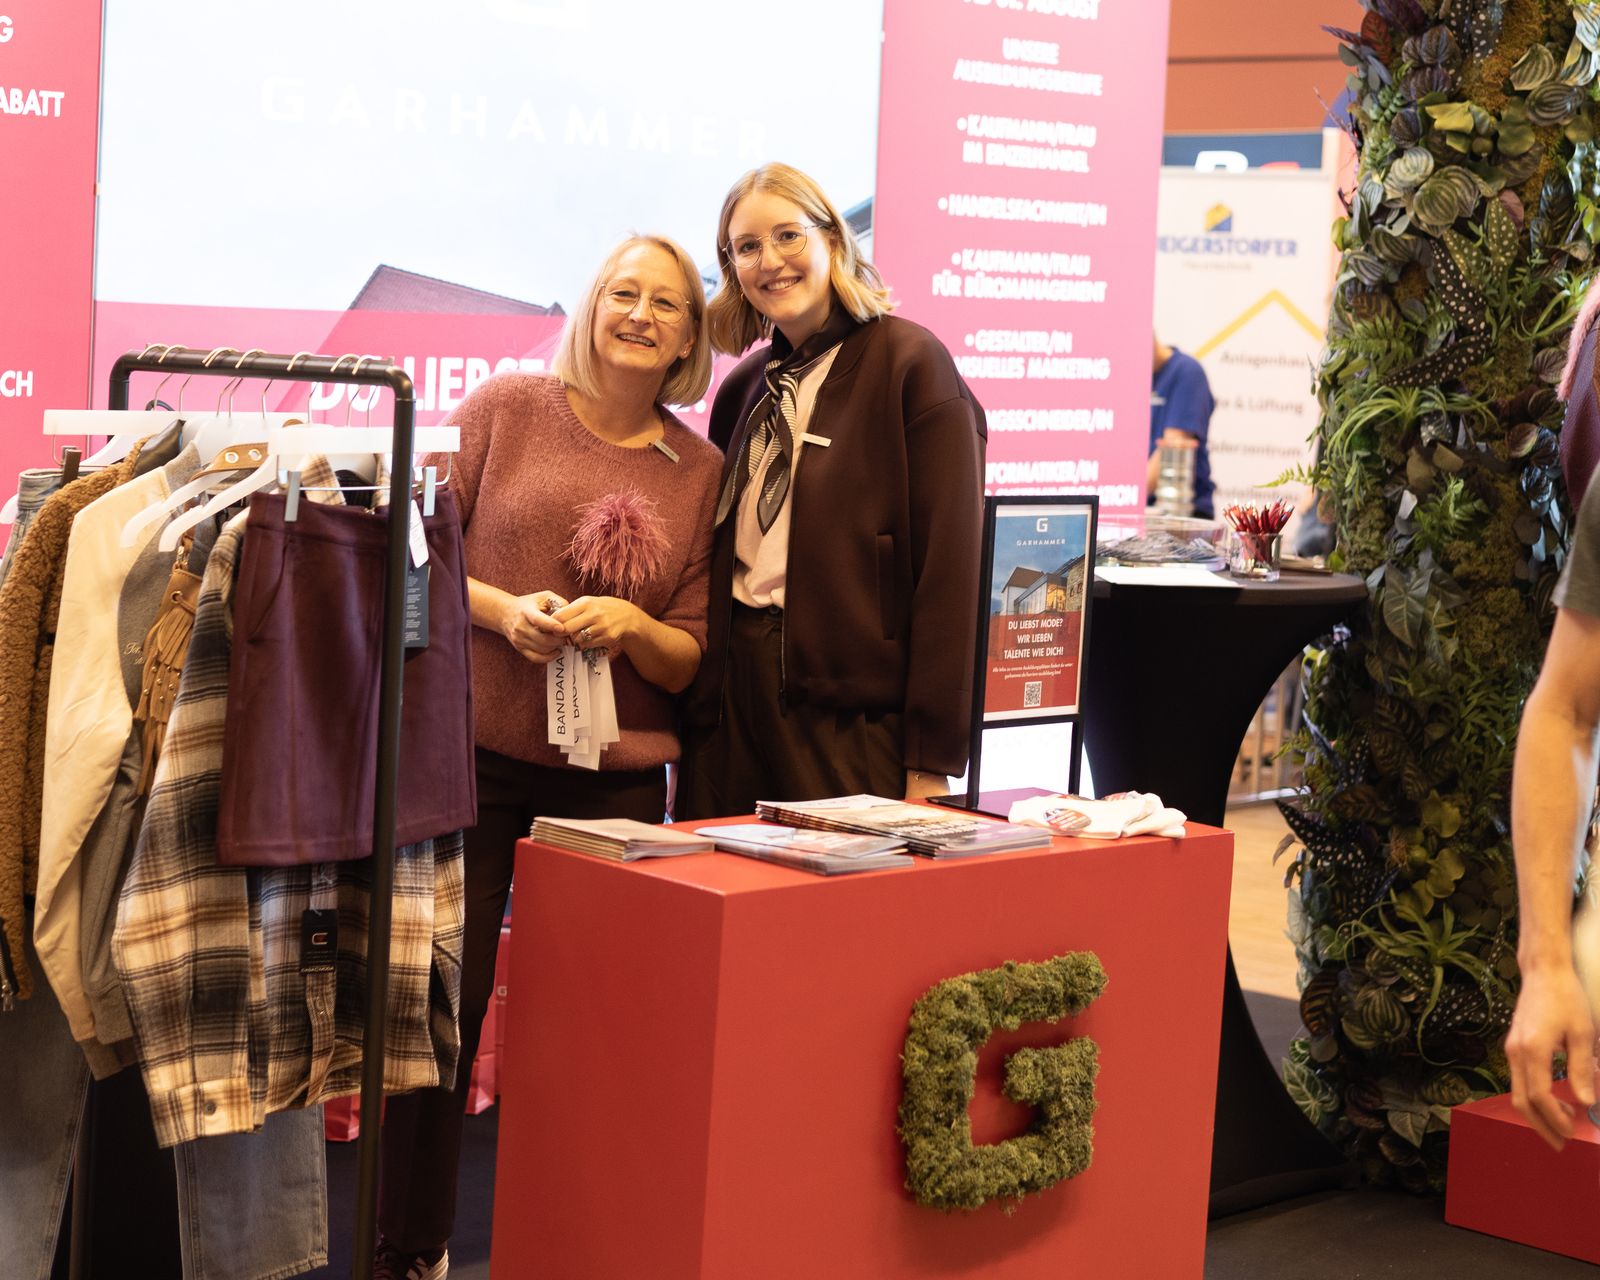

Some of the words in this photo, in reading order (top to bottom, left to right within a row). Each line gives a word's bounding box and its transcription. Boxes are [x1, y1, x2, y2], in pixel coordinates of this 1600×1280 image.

[260, 75, 768, 160] GARHAMMER
[963, 141, 983, 163] IM
[1036, 518, 1048, 532] G
[1008, 621, 1018, 630] DU
[1020, 619, 1039, 629] LIEBST
[1040, 618, 1064, 628] MODE?
[1017, 634, 1031, 644] WIR
[1031, 633, 1053, 643] LIEBEN
[1004, 649, 1031, 659] TALENTE
[1032, 647, 1044, 657] WIE
[1045, 646, 1064, 656] DICH!
[555, 656, 566, 735] BANDANA
[899, 951, 1109, 1210] G
